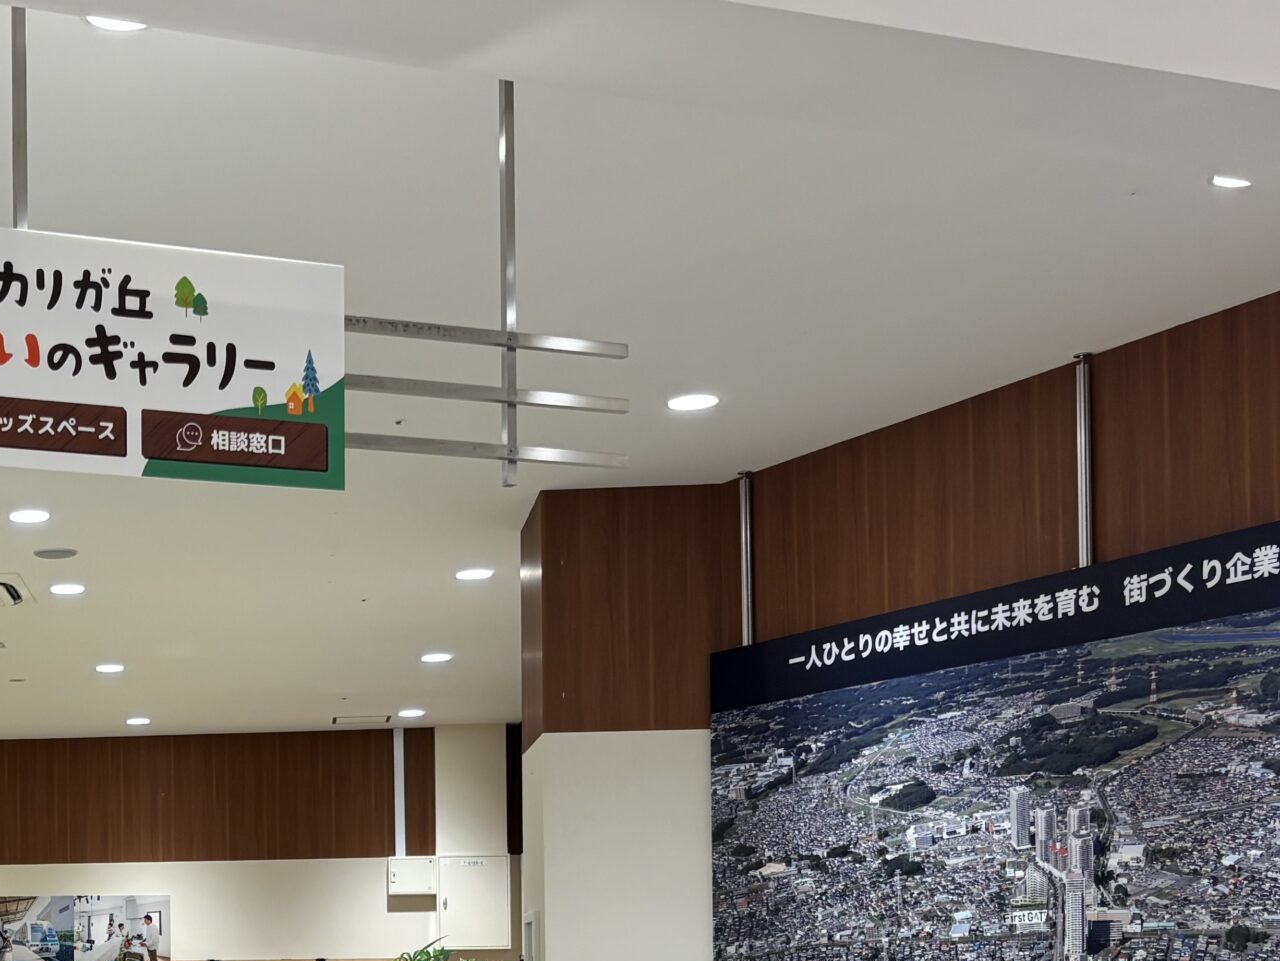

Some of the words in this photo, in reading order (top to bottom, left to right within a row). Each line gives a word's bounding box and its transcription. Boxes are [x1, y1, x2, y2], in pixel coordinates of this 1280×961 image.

[210, 429, 286, 456] 相談窓口
[787, 584, 1100, 671] 一人ひとりの幸せと共に未来を育む
[1123, 543, 1280, 606] 街づくり企業
